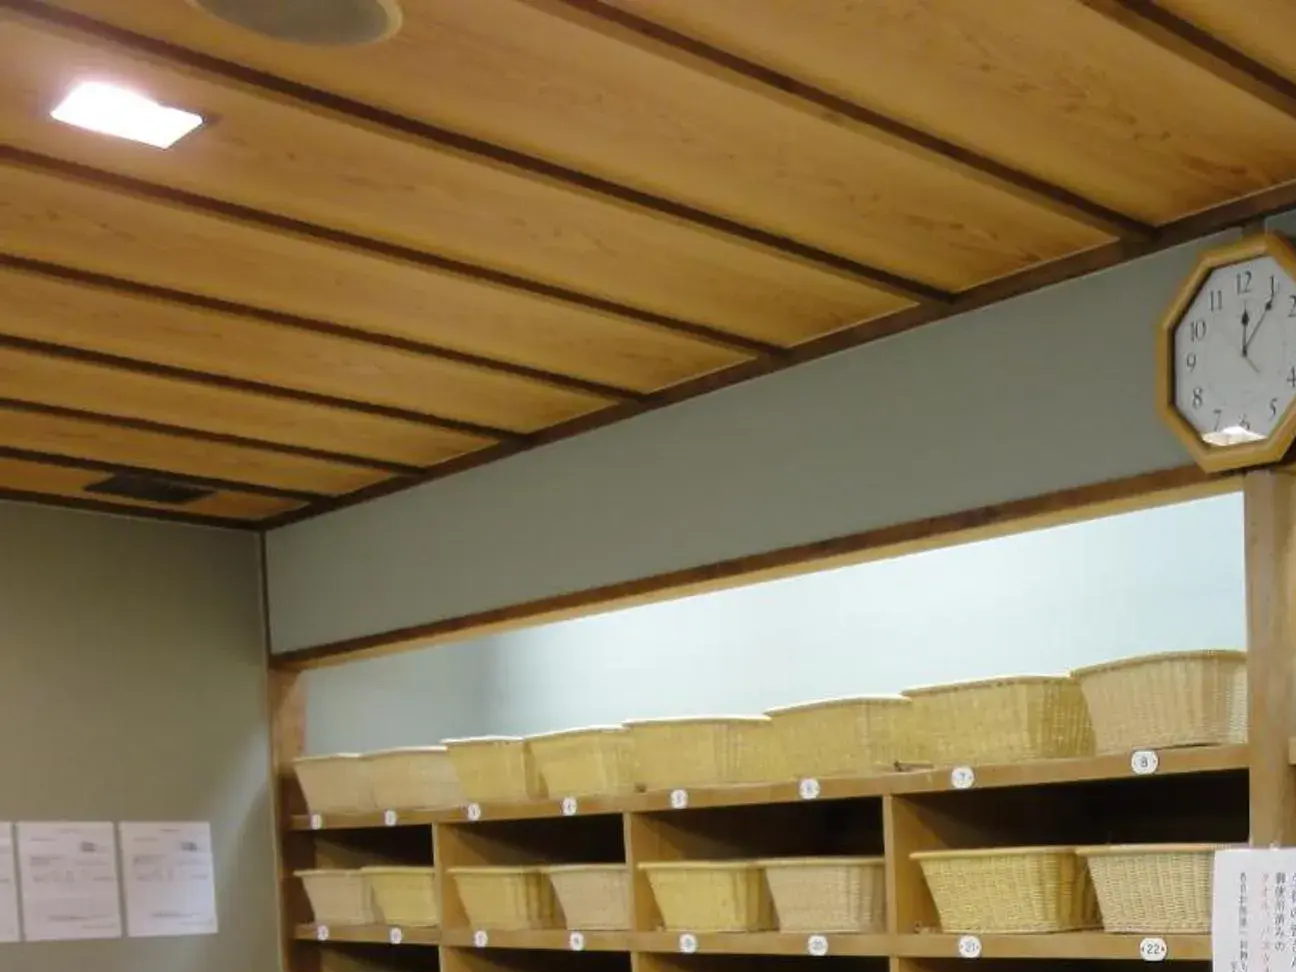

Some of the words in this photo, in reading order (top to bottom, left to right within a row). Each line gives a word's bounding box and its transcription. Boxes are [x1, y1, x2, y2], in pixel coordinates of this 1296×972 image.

[1236, 271, 1252, 295] 12
[1210, 290, 1222, 311] 11
[1190, 321, 1207, 342] 10
[1186, 353, 1197, 373] 9
[1192, 388, 1203, 410] 8
[1269, 398, 1278, 421] 5
[1213, 409, 1222, 431] 7
[1140, 756, 1148, 768] 8
[1147, 943, 1160, 955] 22
